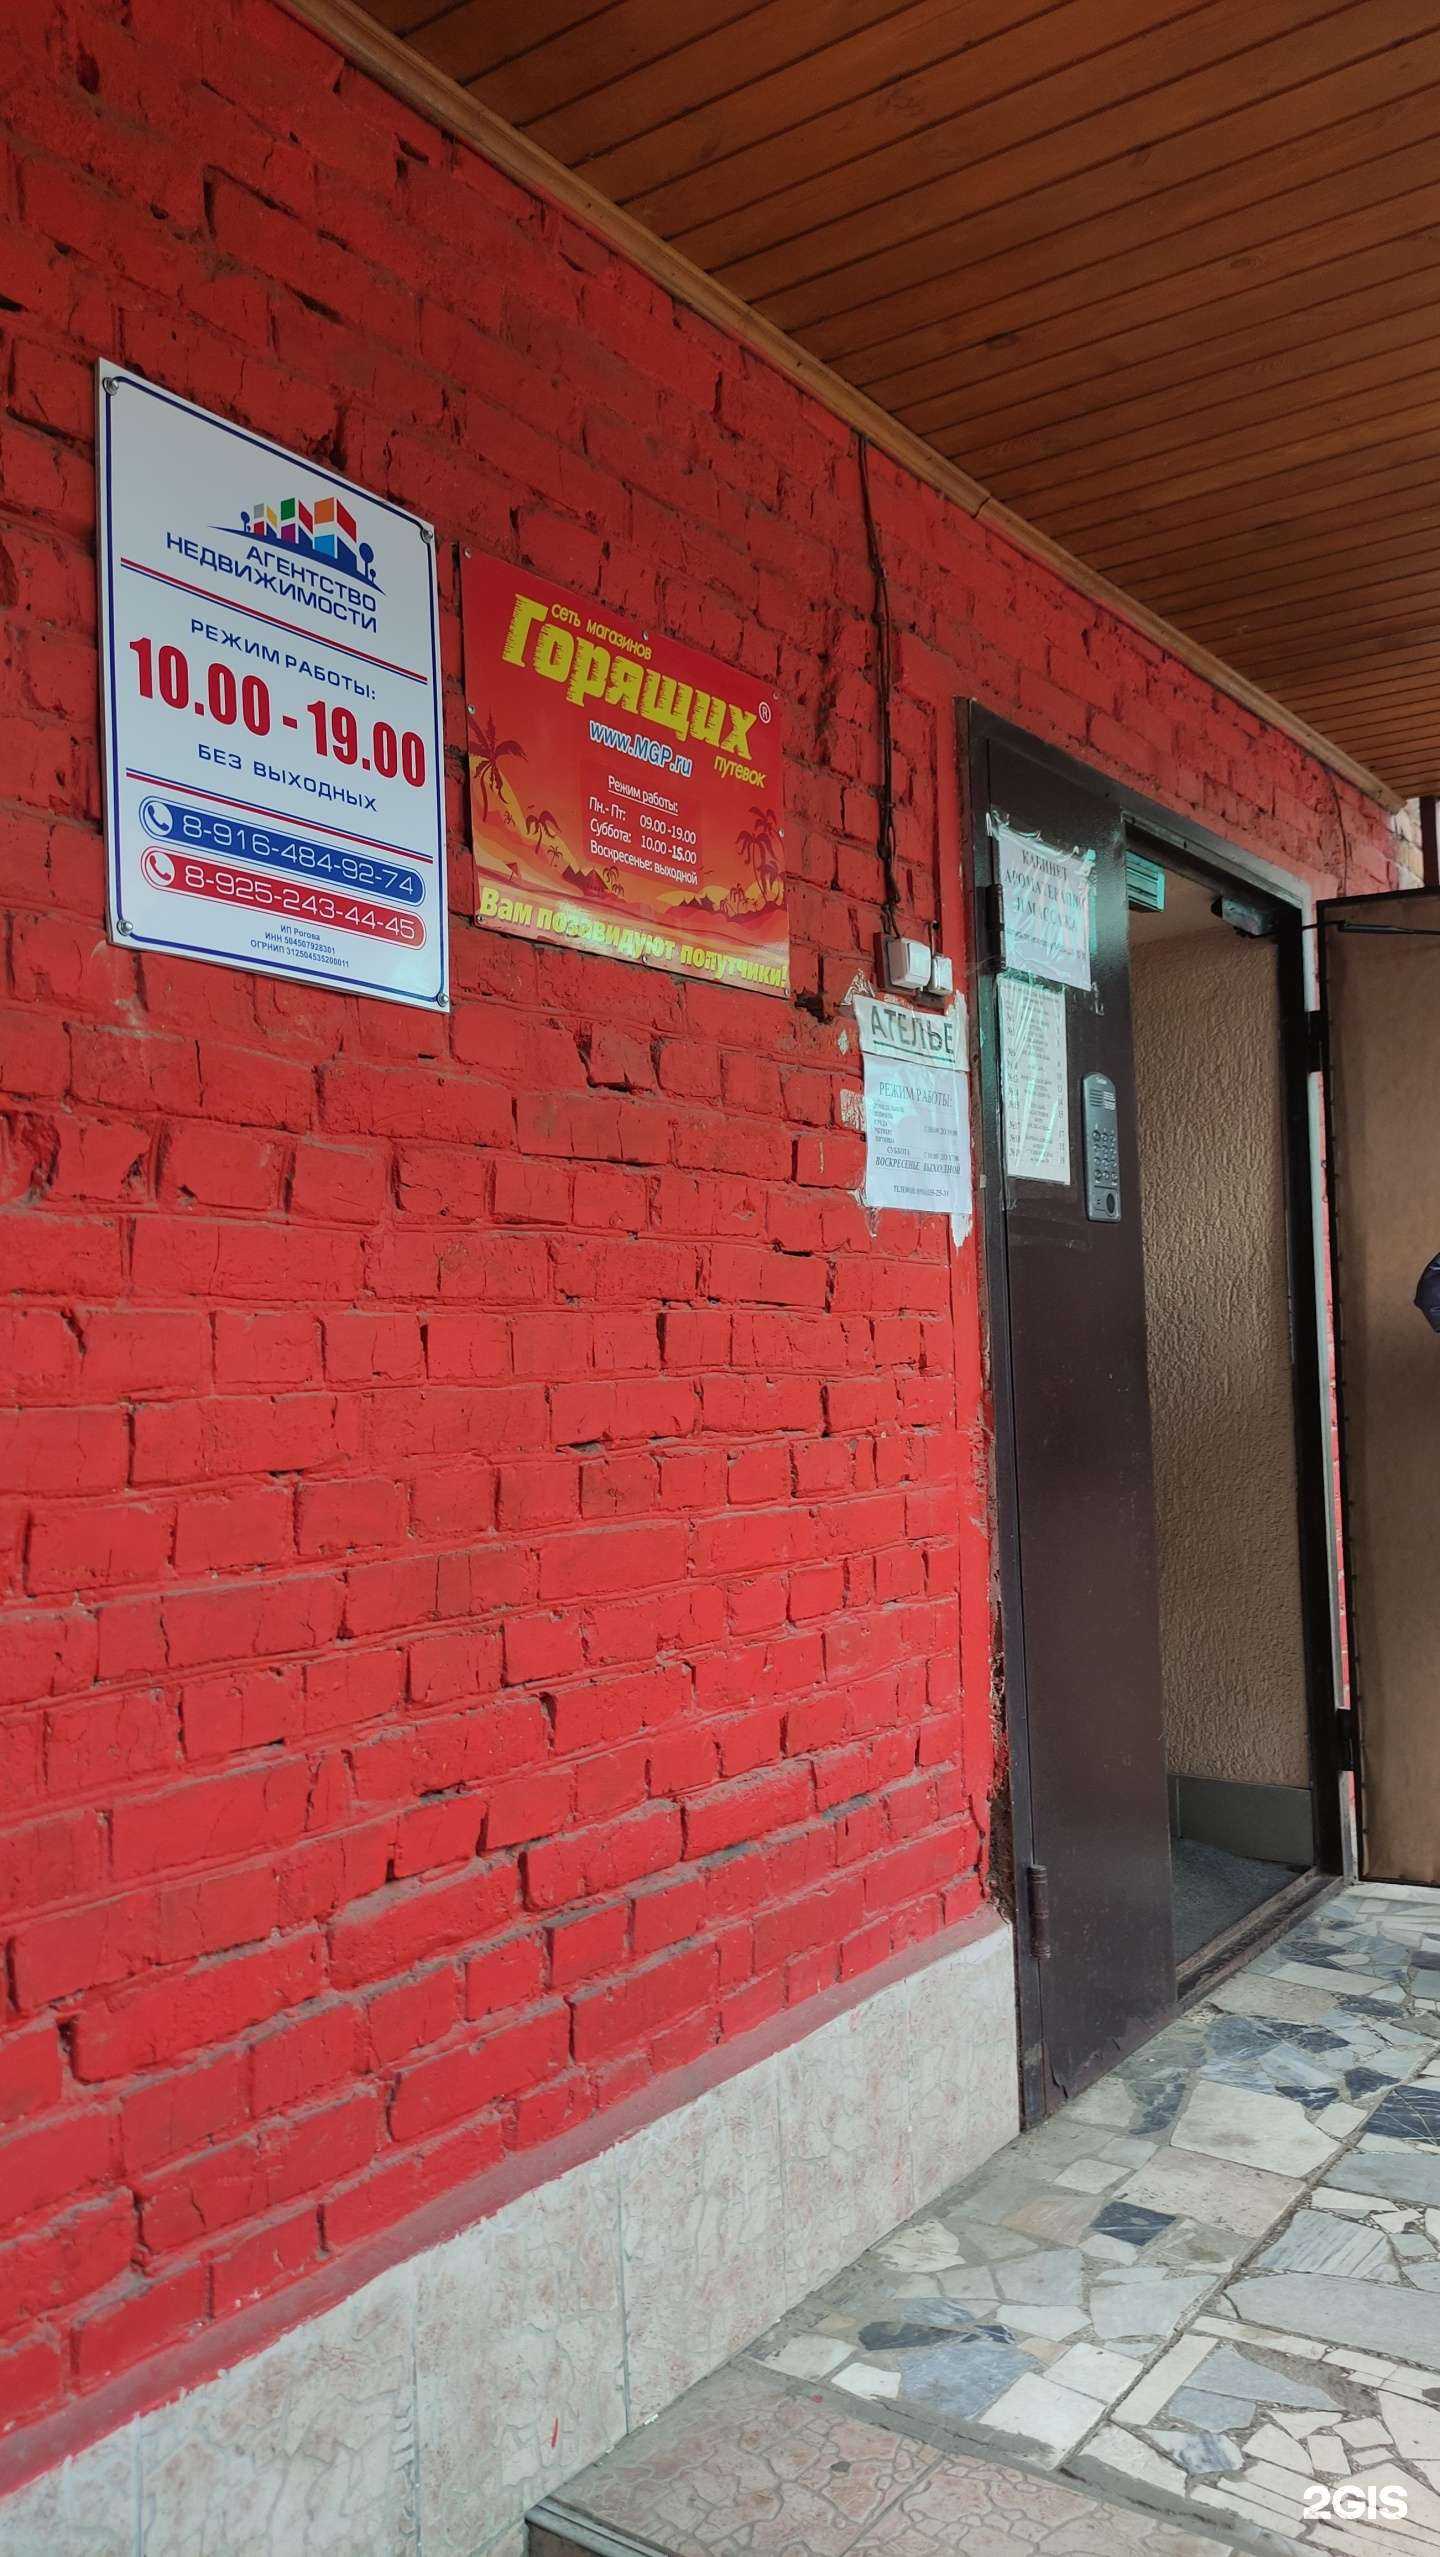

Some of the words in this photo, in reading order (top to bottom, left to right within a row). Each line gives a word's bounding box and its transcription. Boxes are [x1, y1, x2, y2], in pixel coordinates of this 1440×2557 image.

[167, 532, 377, 633] НЕДВИЖИМОСТИ
[246, 546, 376, 612] АГЕНТСТВО
[191, 618, 280, 664] РЕЖИМ
[285, 655, 376, 700] РАБОТЫ:
[551, 604, 581, 628] сеть
[586, 619, 652, 660] магазинов
[502, 593, 758, 761] Горящих
[198, 743, 242, 771] БЕЗ
[254, 761, 377, 812] ВЫХОДНЫХ
[589, 719, 692, 778] www.MGP.ru
[713, 755, 768, 789] путевок
[607, 775, 640, 799] Режим
[642, 791, 679, 813] работы:
[181, 814, 415, 896] 8-916-484-92-74
[590, 818, 632, 843] Суббота:
[590, 839, 653, 872] Воскресенье:
[654, 863, 698, 886] выходной
[185, 864, 415, 940] 8-925-243-44-45
[265, 932, 282, 943] ИНН
[280, 924, 292, 934] ИП
[293, 927, 320, 940] Рогова
[479, 887, 533, 927] Вам
[536, 906, 677, 960] позавидуют
[680, 943, 788, 989] попутчики!
[871, 1005, 954, 1054] АТЕЛЬЕ
